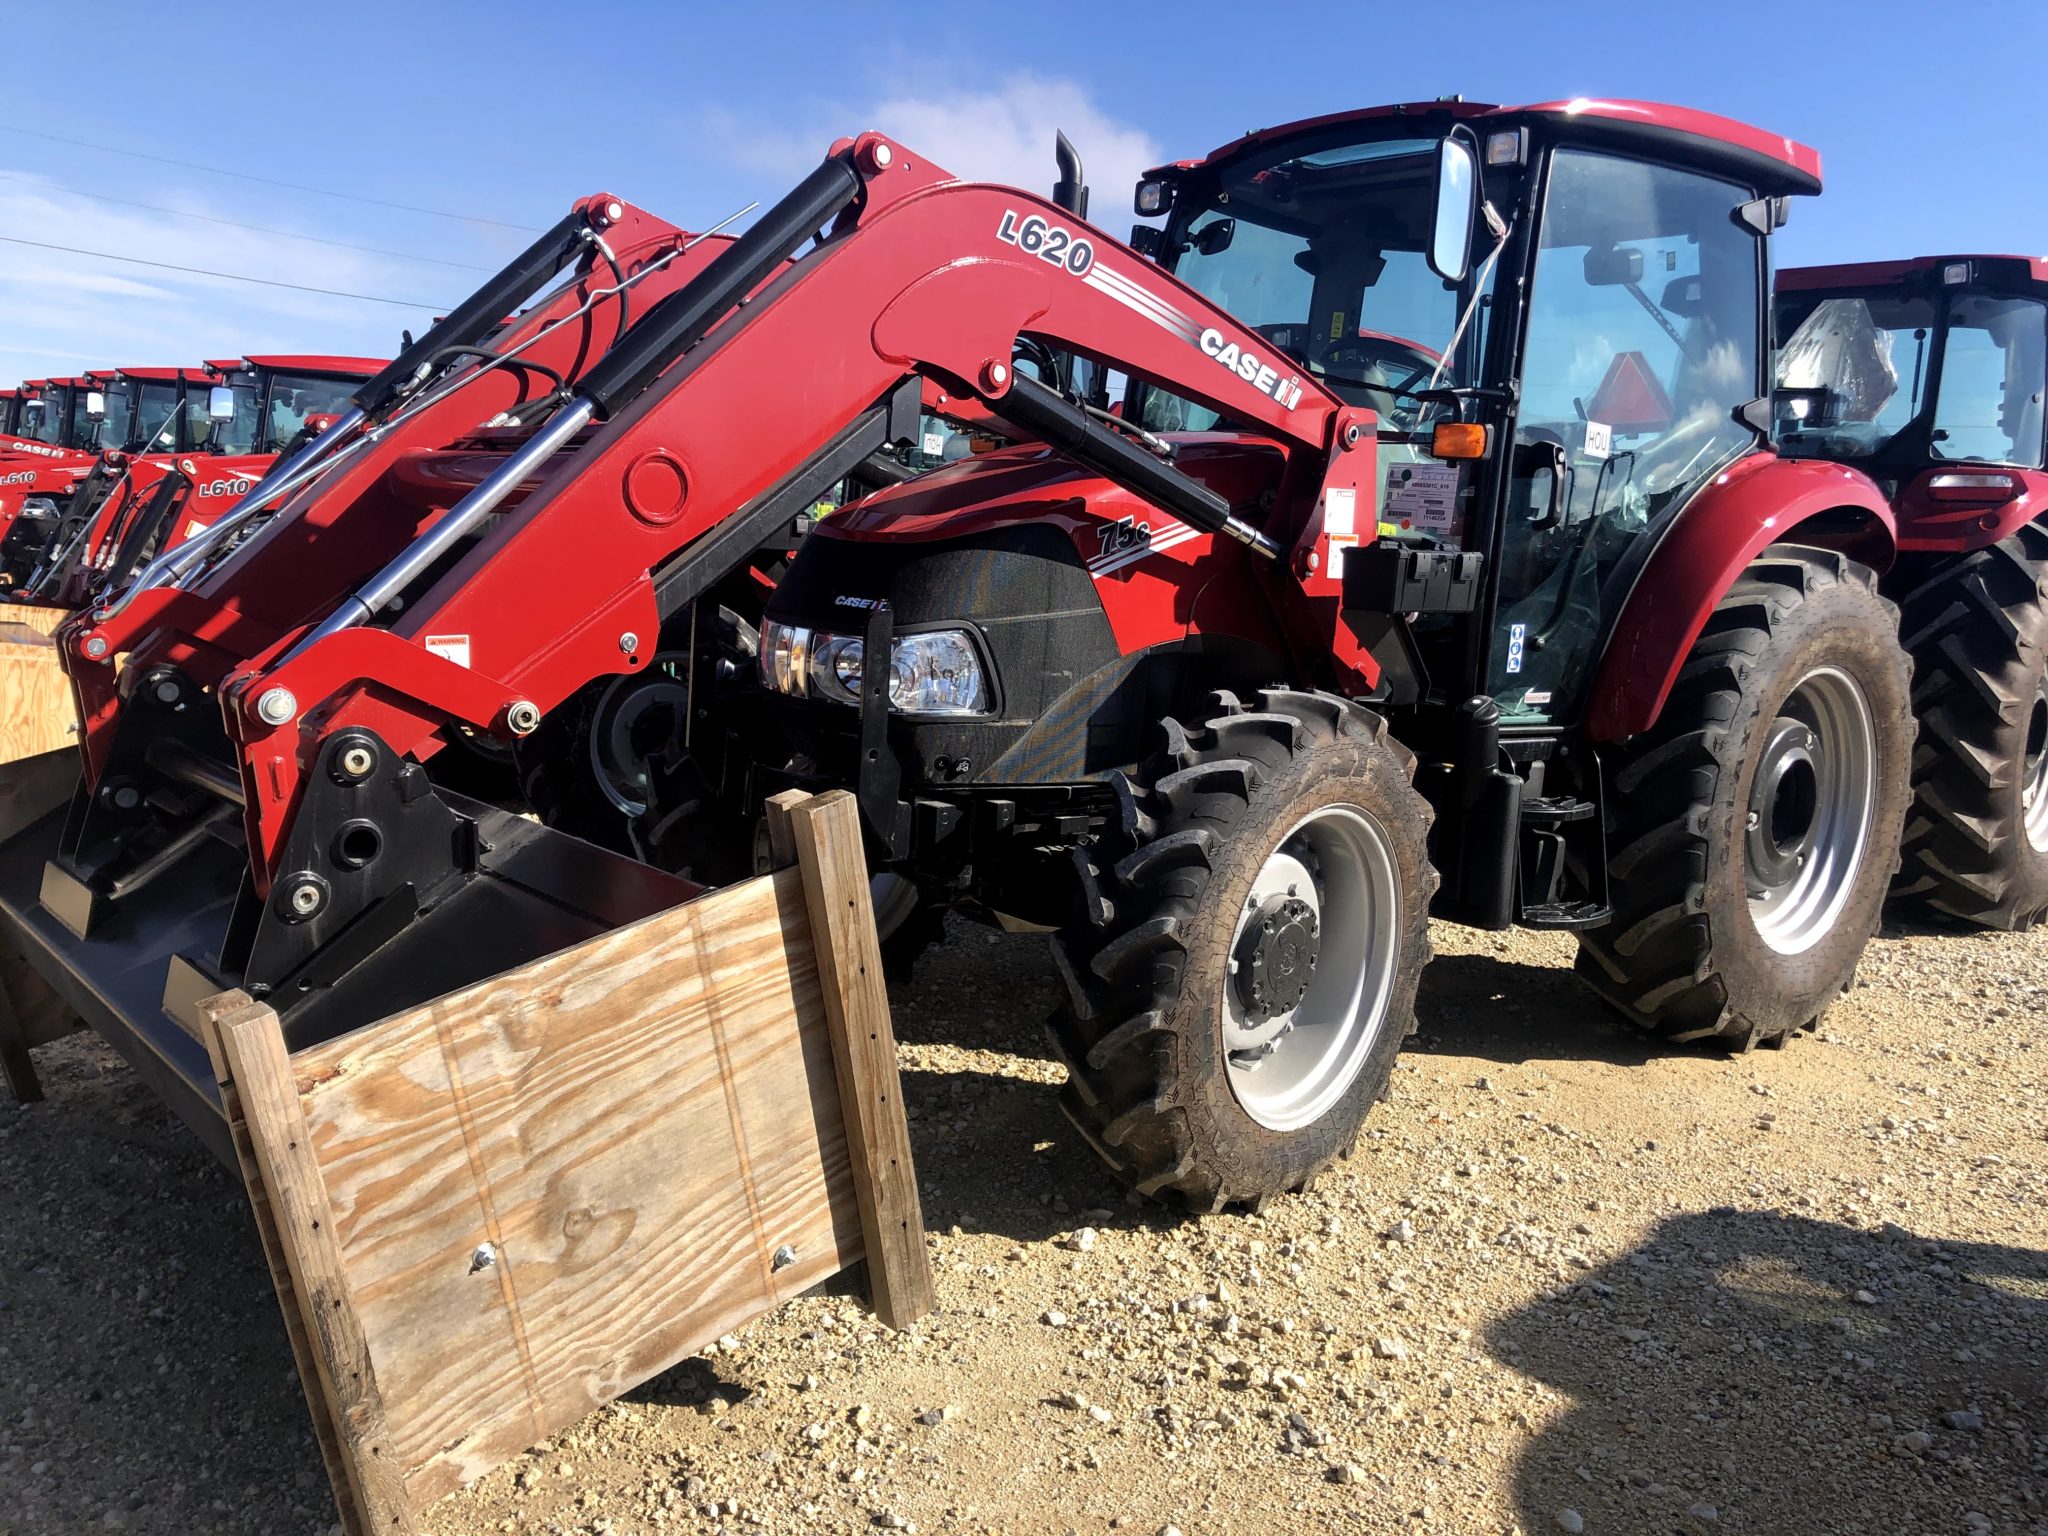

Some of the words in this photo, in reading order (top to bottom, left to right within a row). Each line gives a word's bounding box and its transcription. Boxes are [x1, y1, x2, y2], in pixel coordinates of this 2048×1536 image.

[996, 209, 1093, 276] L620
[1200, 328, 1278, 395] CASE
[13, 442, 51, 457] CASE
[1588, 430, 1608, 451] HOU
[0, 471, 37, 485] L610
[199, 478, 250, 497] L610
[835, 596, 873, 609] CASE
